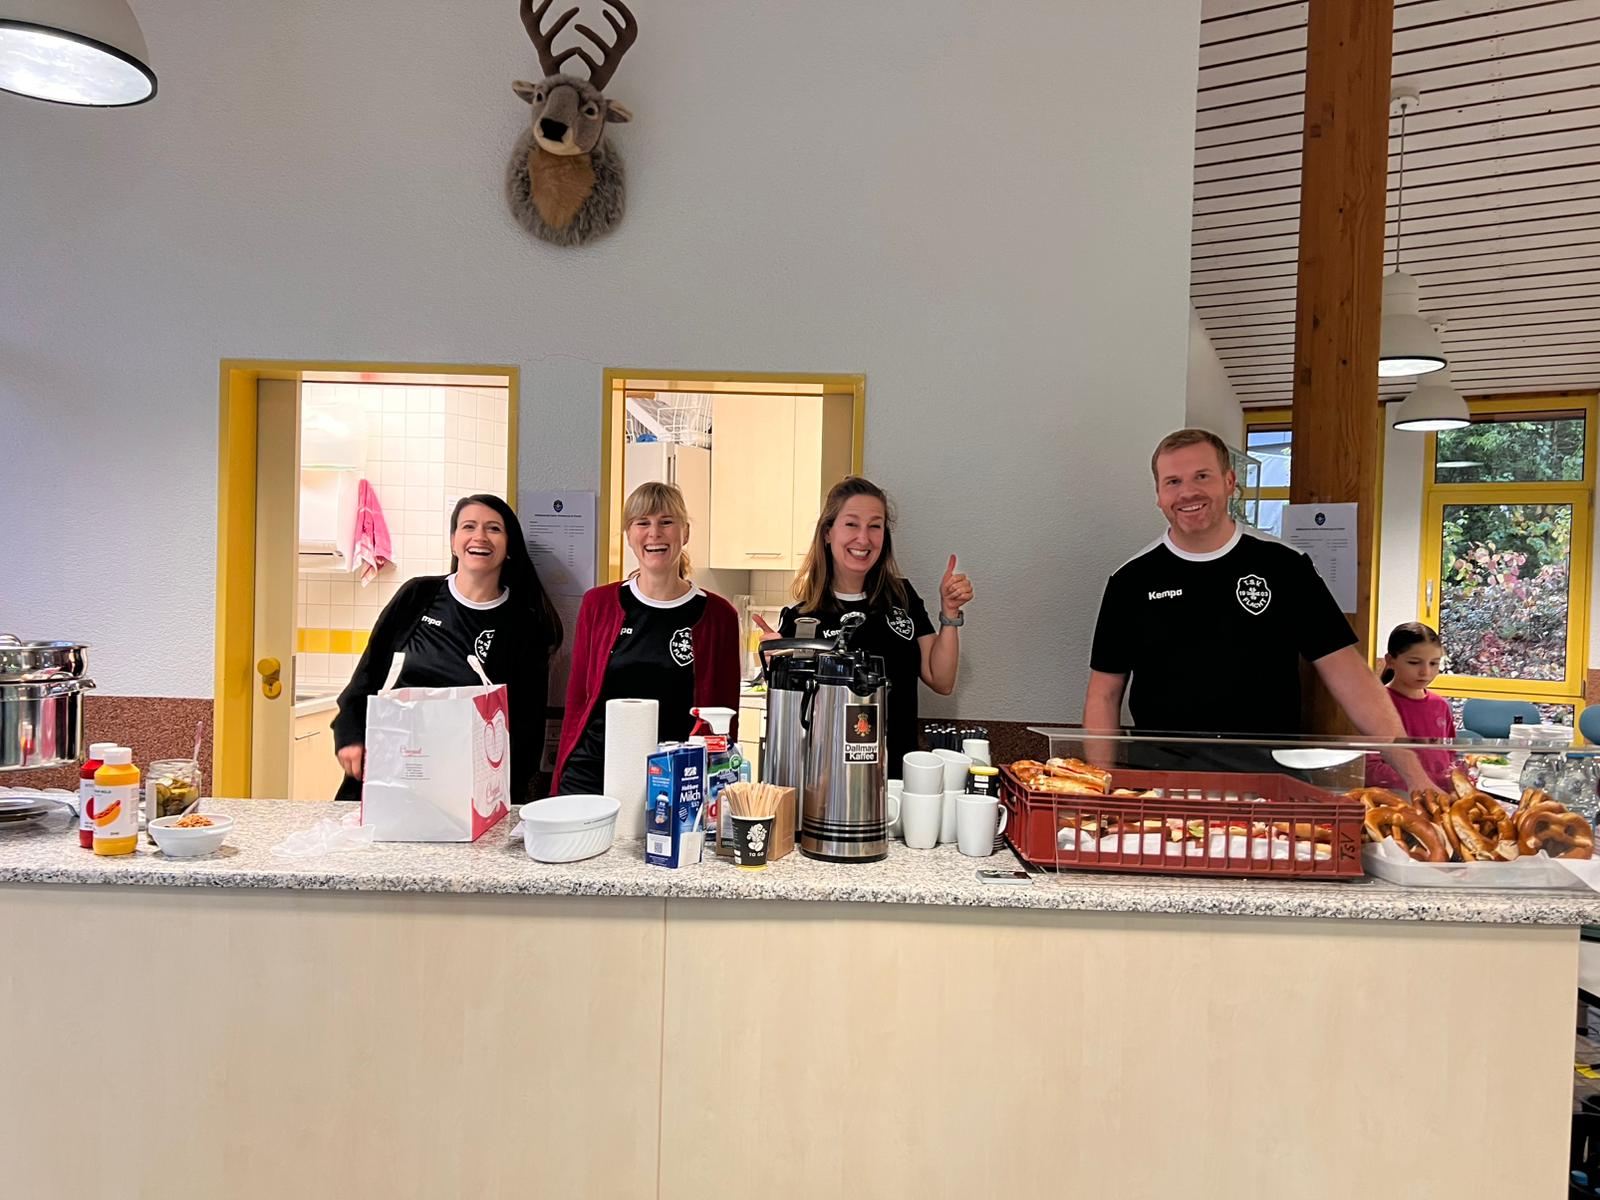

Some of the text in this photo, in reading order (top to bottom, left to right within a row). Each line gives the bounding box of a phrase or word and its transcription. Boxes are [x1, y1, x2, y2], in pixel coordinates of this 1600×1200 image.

[1148, 589, 1183, 601] Kempa
[1242, 597, 1267, 609] FLACHT
[421, 615, 442, 627] mpa
[845, 744, 878, 753] Dallmayr
[849, 752, 875, 761] Kaffee
[680, 790, 701, 803] Milch
